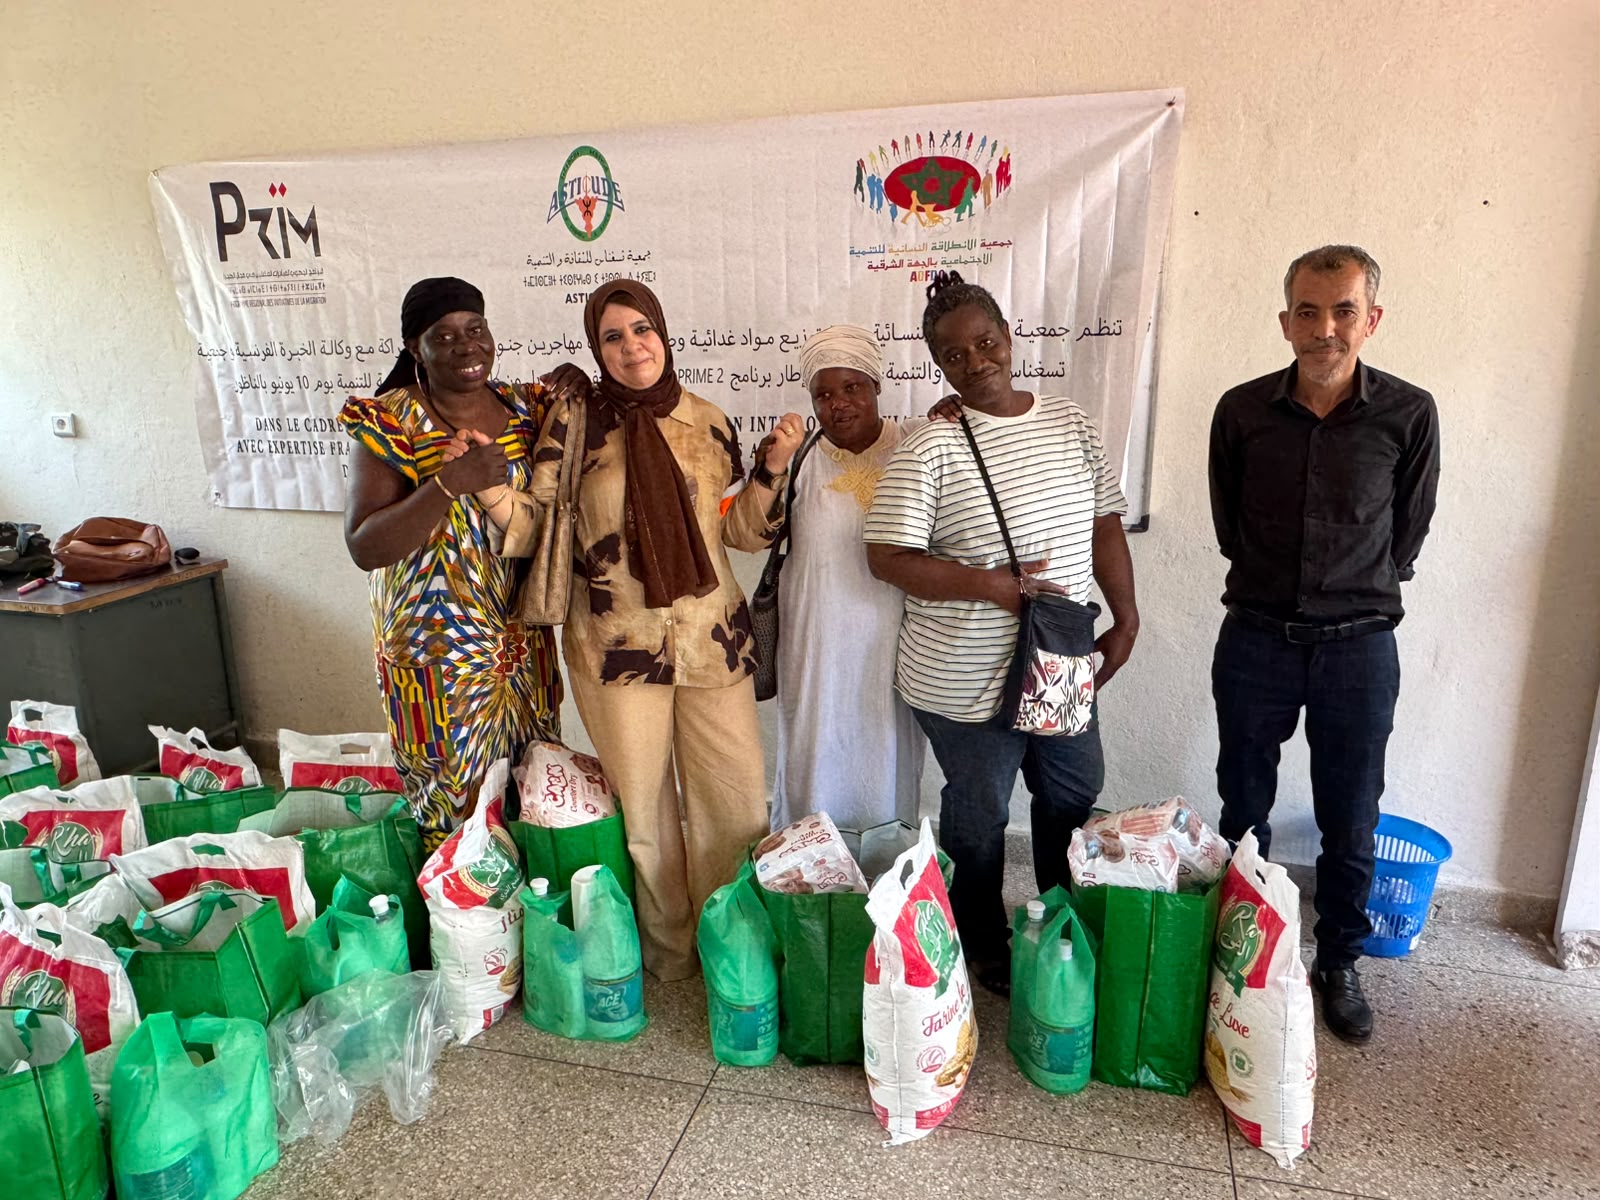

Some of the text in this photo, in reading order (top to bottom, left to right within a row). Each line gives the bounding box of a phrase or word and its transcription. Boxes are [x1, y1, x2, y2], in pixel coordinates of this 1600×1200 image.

[849, 244, 886, 258] للتنمية
[931, 238, 977, 253] الانطلاقة
[980, 238, 1013, 250] جمعية
[867, 253, 993, 273] الاجتماعية بالجهة الشرقية
[565, 293, 591, 304] ASTI
[740, 328, 775, 351] مواد
[874, 322, 926, 347] نسائية
[1014, 318, 1070, 343] جمعية
[1076, 317, 1123, 342] تنظم
[320, 339, 351, 360] وكالة
[497, 339, 523, 357] جنو
[527, 333, 583, 356] مهاجرين
[690, 329, 736, 352] غدائية
[197, 342, 227, 362] جمعية
[235, 341, 278, 362] الفرنسية
[280, 340, 317, 362] الخبرة
[355, 344, 375, 362] مع
[296, 375, 310, 390] 10
[337, 373, 372, 394] للتنمية
[678, 368, 724, 384] PRIME 2
[730, 366, 772, 391] برنامج
[886, 361, 942, 386] والتنمية
[235, 374, 267, 394] بالناظور
[271, 378, 294, 394] يونيو
[314, 378, 334, 394] يوم
[256, 417, 344, 432] DANS LE CADRE
[237, 440, 264, 454] AVEC
[268, 440, 326, 455] EXPERTISE
[598, 992, 621, 1008] ACE
[922, 1000, 960, 1037] Farine
[1219, 1002, 1251, 1039] Luxe
